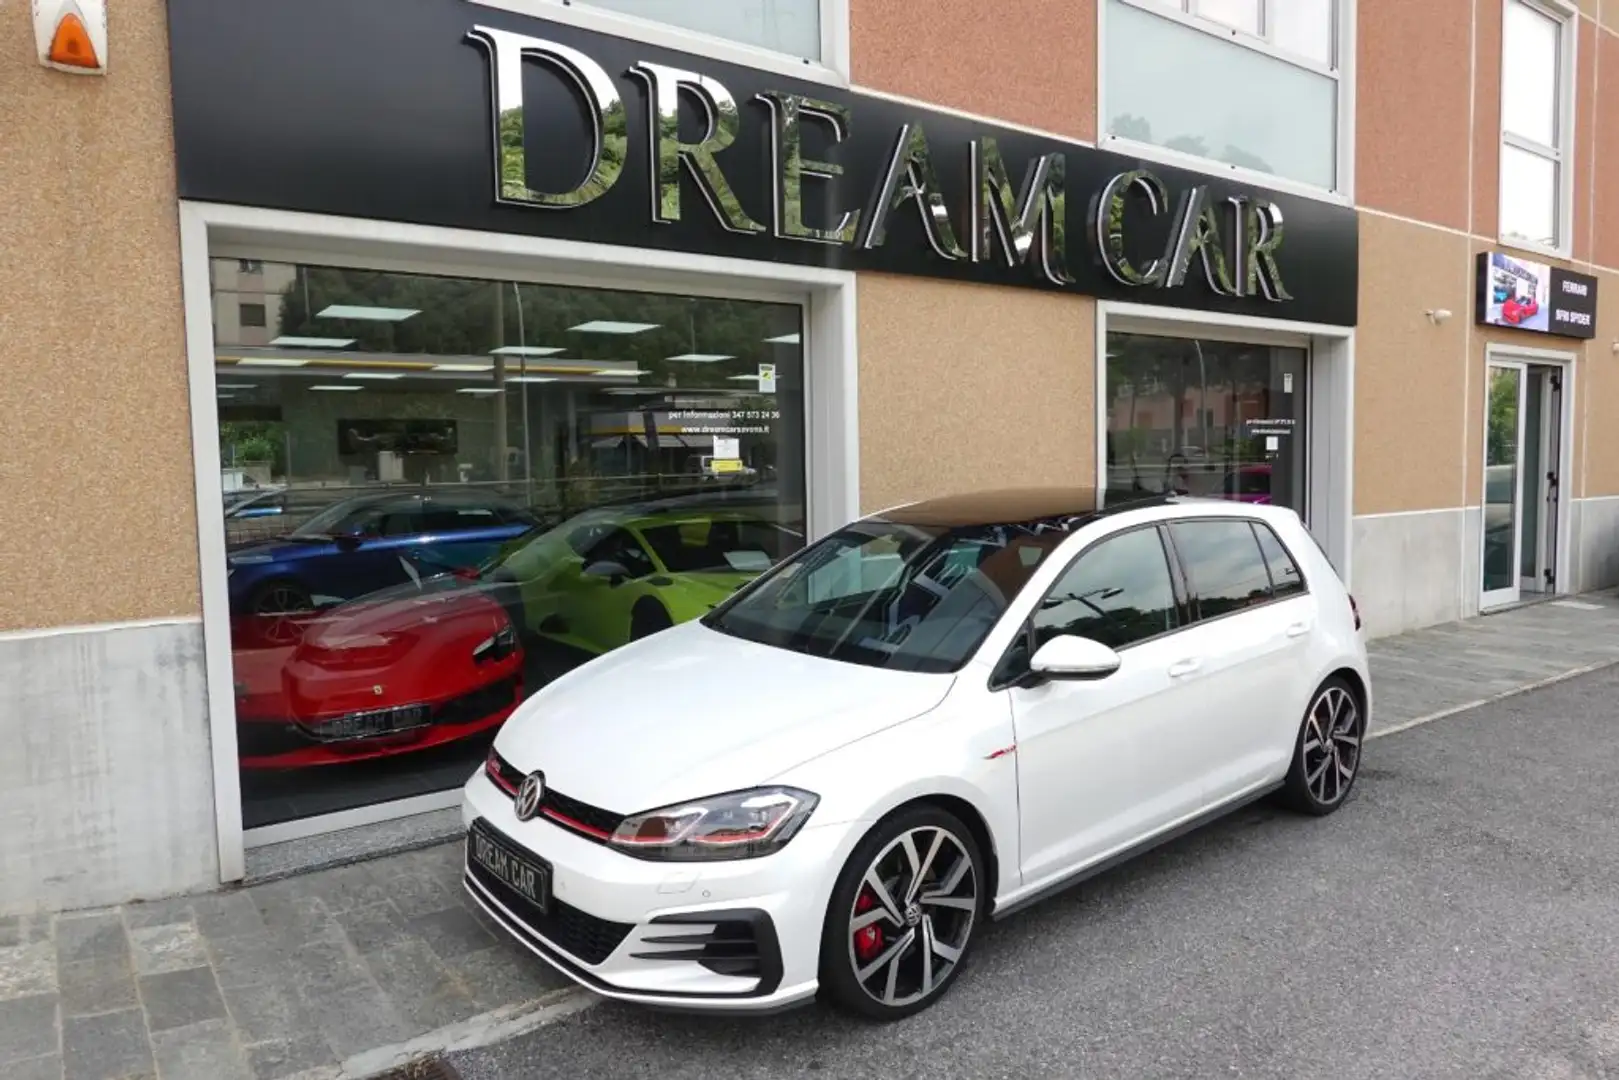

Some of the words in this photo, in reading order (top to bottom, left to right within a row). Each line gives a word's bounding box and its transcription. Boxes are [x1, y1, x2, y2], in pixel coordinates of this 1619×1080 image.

[465, 24, 1075, 285] DREAM
[1087, 166, 1294, 302] CAR
[668, 411, 682, 420] per
[511, 858, 537, 900] CAR
